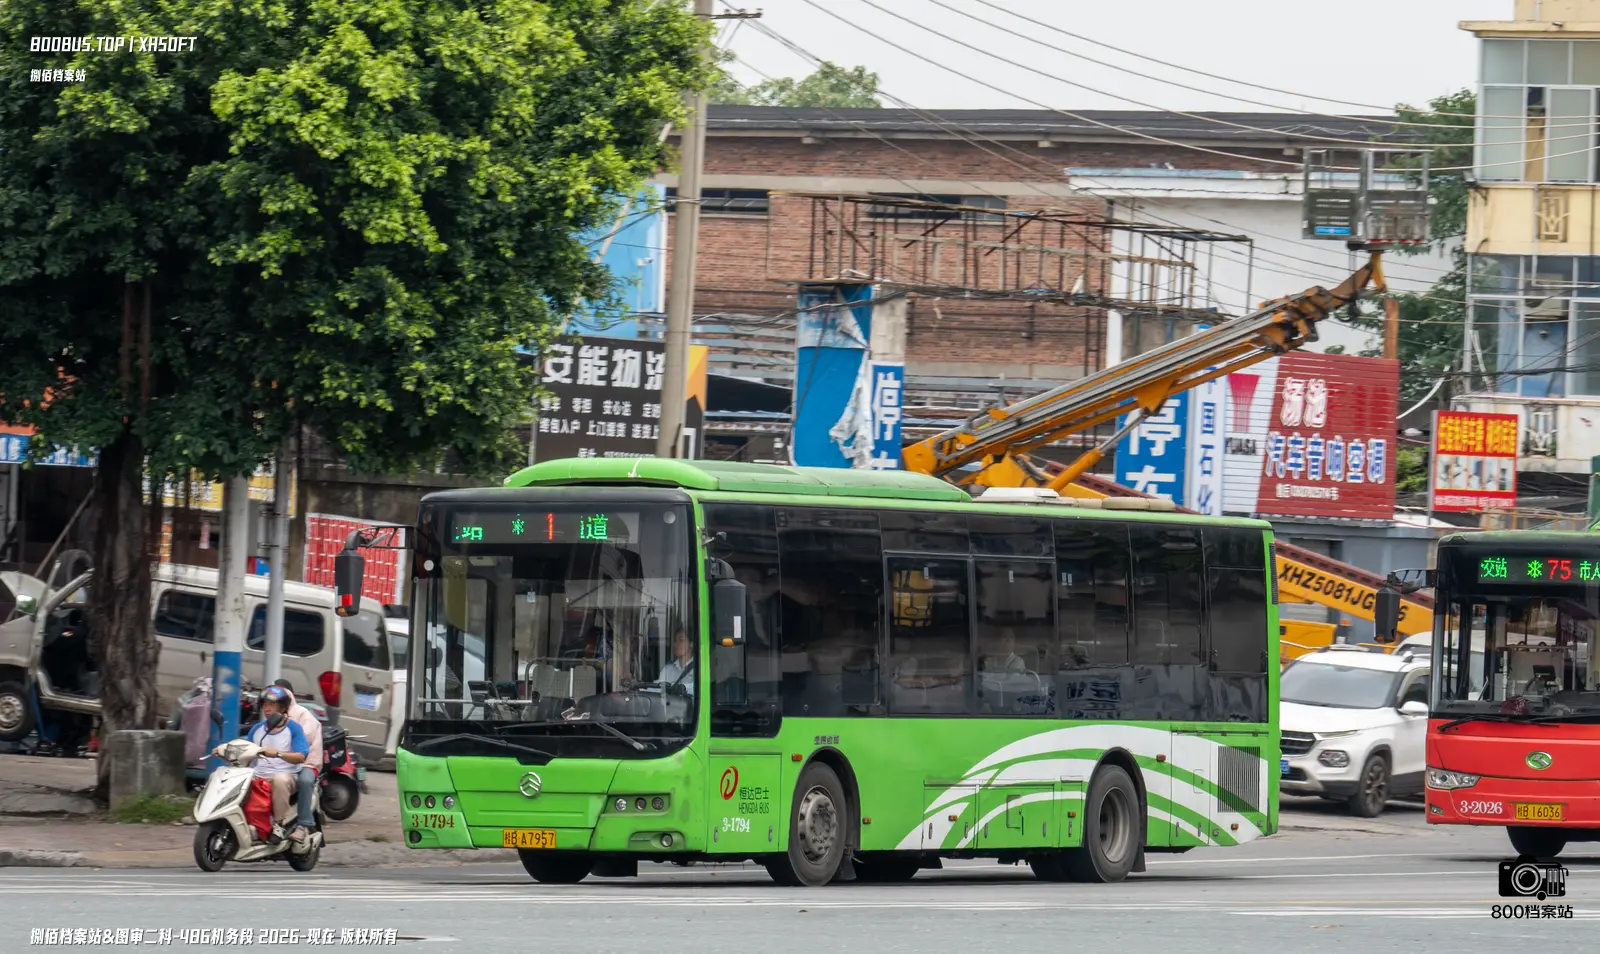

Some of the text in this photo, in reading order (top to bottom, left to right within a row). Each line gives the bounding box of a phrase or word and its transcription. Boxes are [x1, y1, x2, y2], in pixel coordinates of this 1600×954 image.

[872, 372, 901, 470] 停
[1265, 431, 1387, 484] 汽车音响空调
[547, 513, 553, 541] 1
[1480, 557, 1508, 579] 交站
[1547, 559, 1572, 581] 75
[1278, 563, 1409, 622] XHZ5081JG6
[739, 787, 770, 801] 恒达巴士
[738, 802, 770, 815] HENGDA BUS
[1459, 800, 1503, 815] 3-2026
[411, 813, 455, 829] 3-1794
[721, 816, 751, 833] 3-1794
